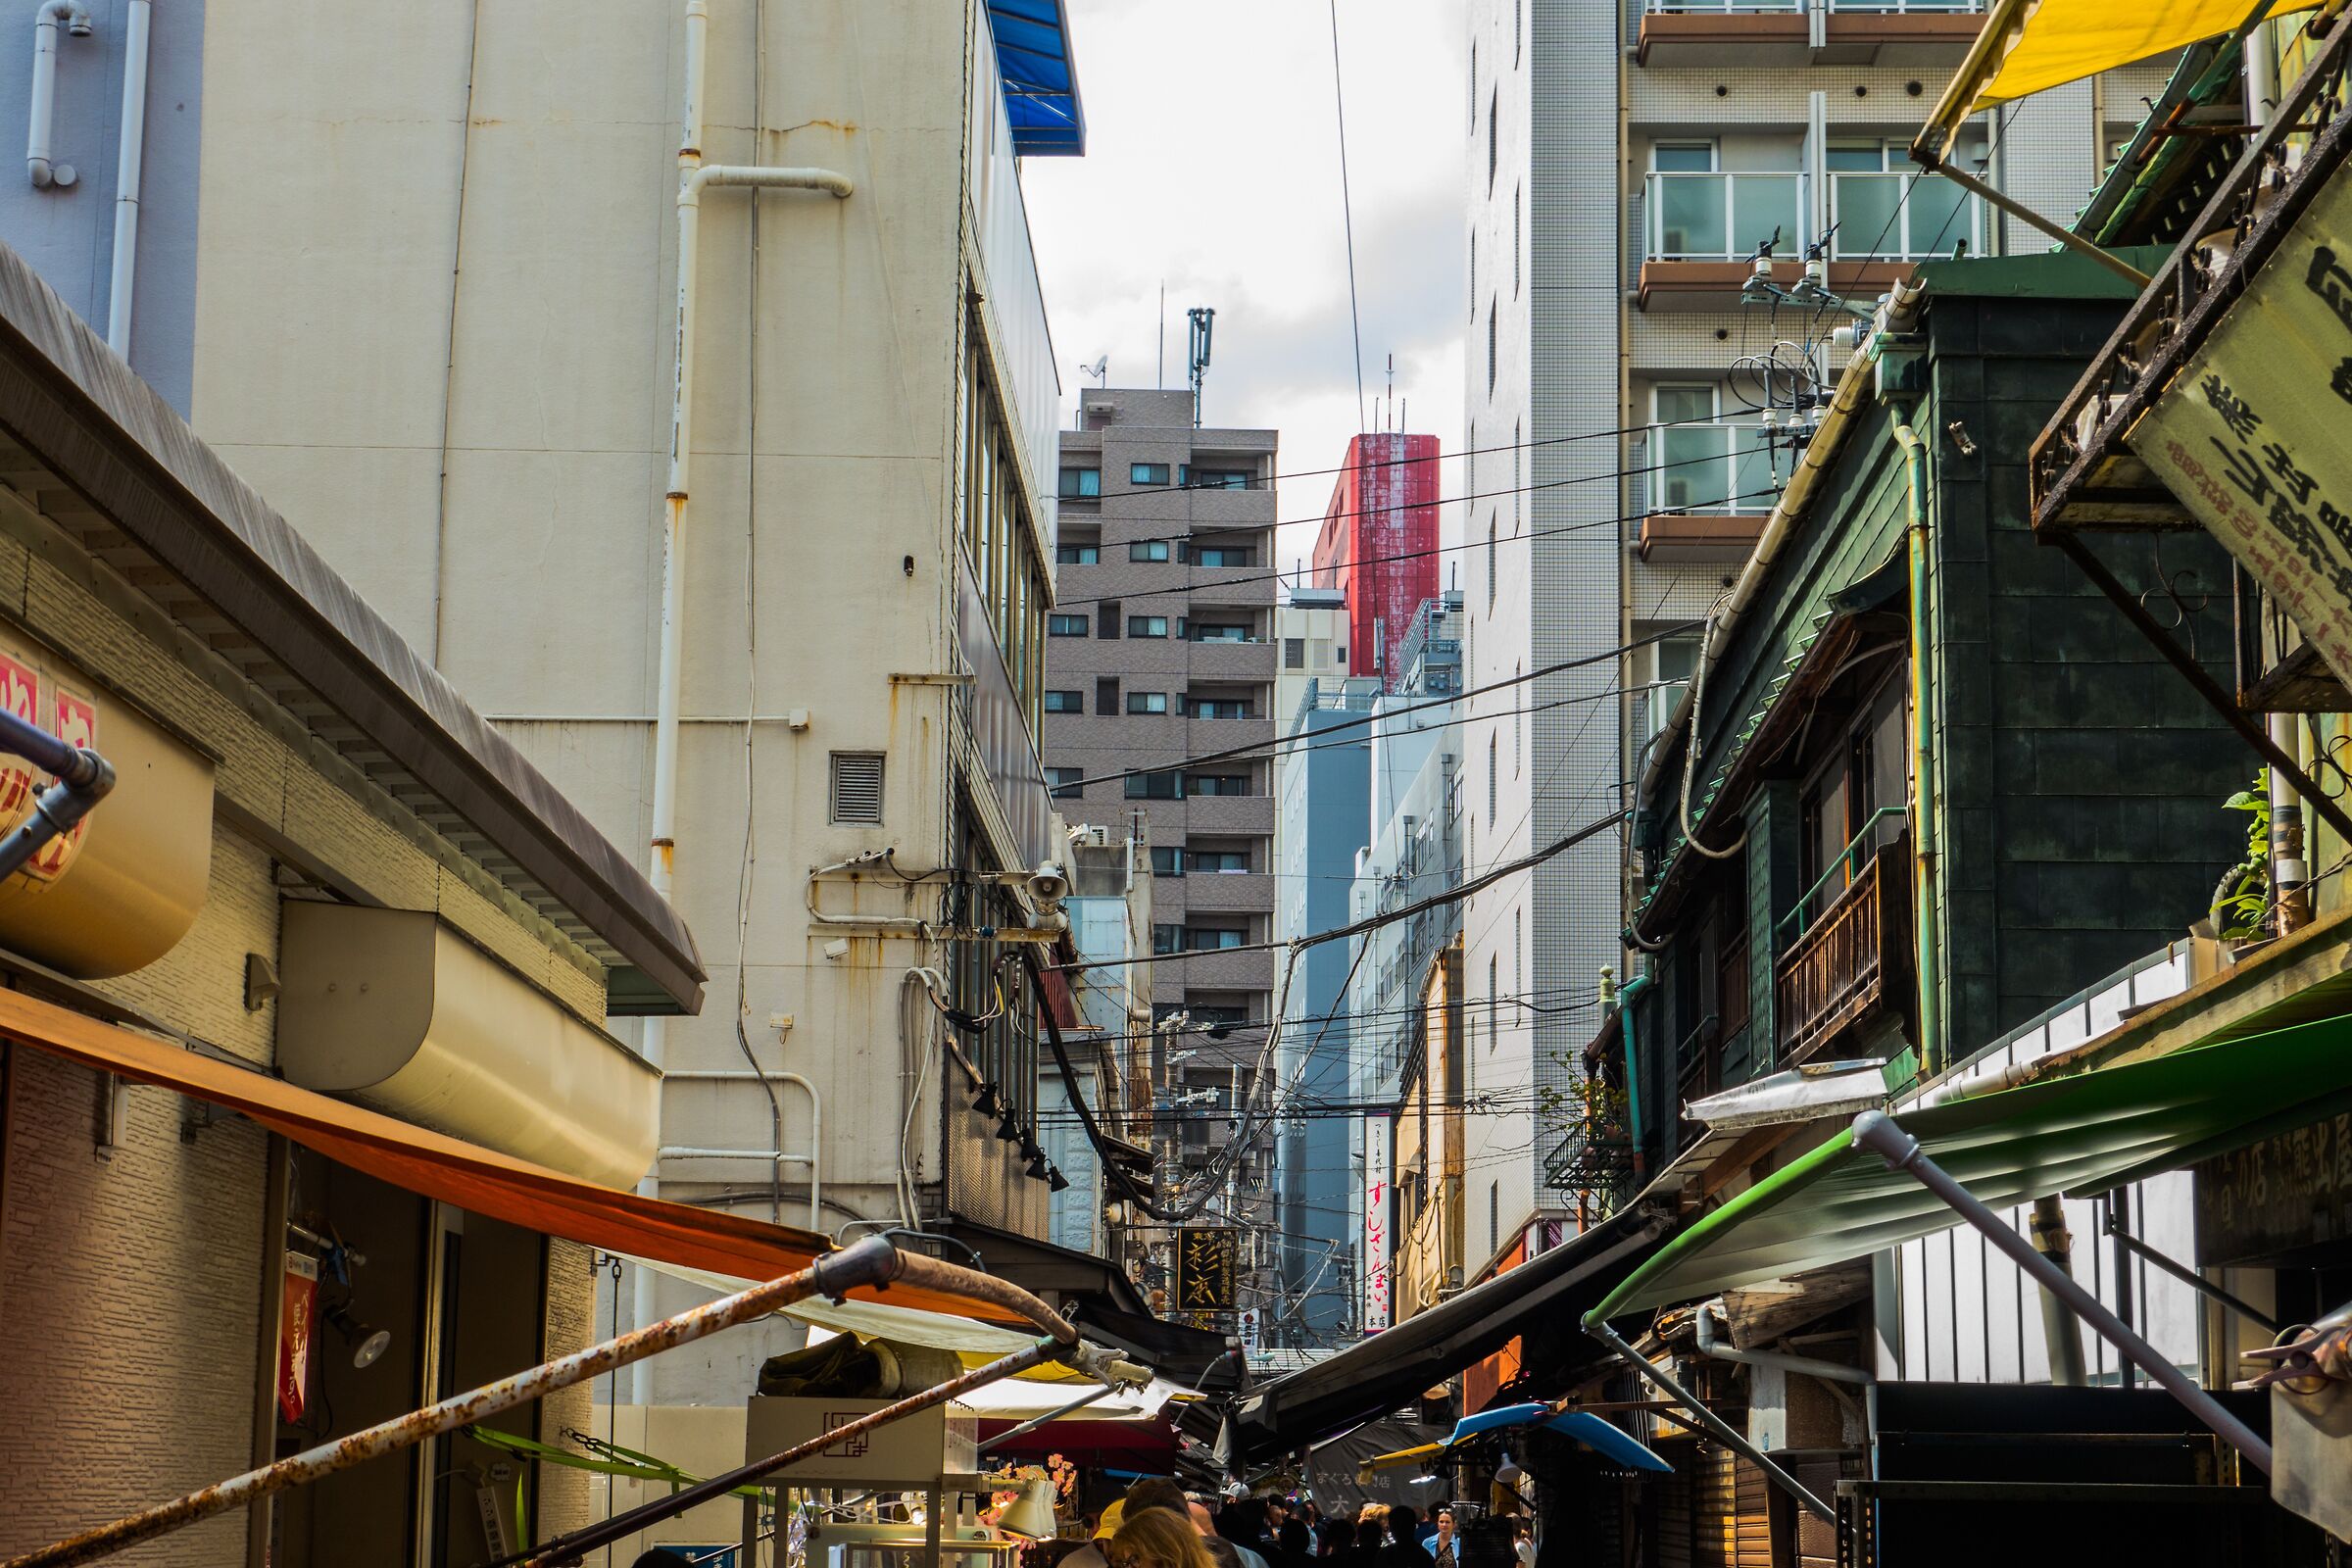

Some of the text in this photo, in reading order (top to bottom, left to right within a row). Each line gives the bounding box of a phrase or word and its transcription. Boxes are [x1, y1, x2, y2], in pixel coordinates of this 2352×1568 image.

[1368, 1180, 1388, 1302] すしざんまい
[1368, 1315, 1386, 1328] 本店
[1316, 1473, 1391, 1489] まぐろ店
